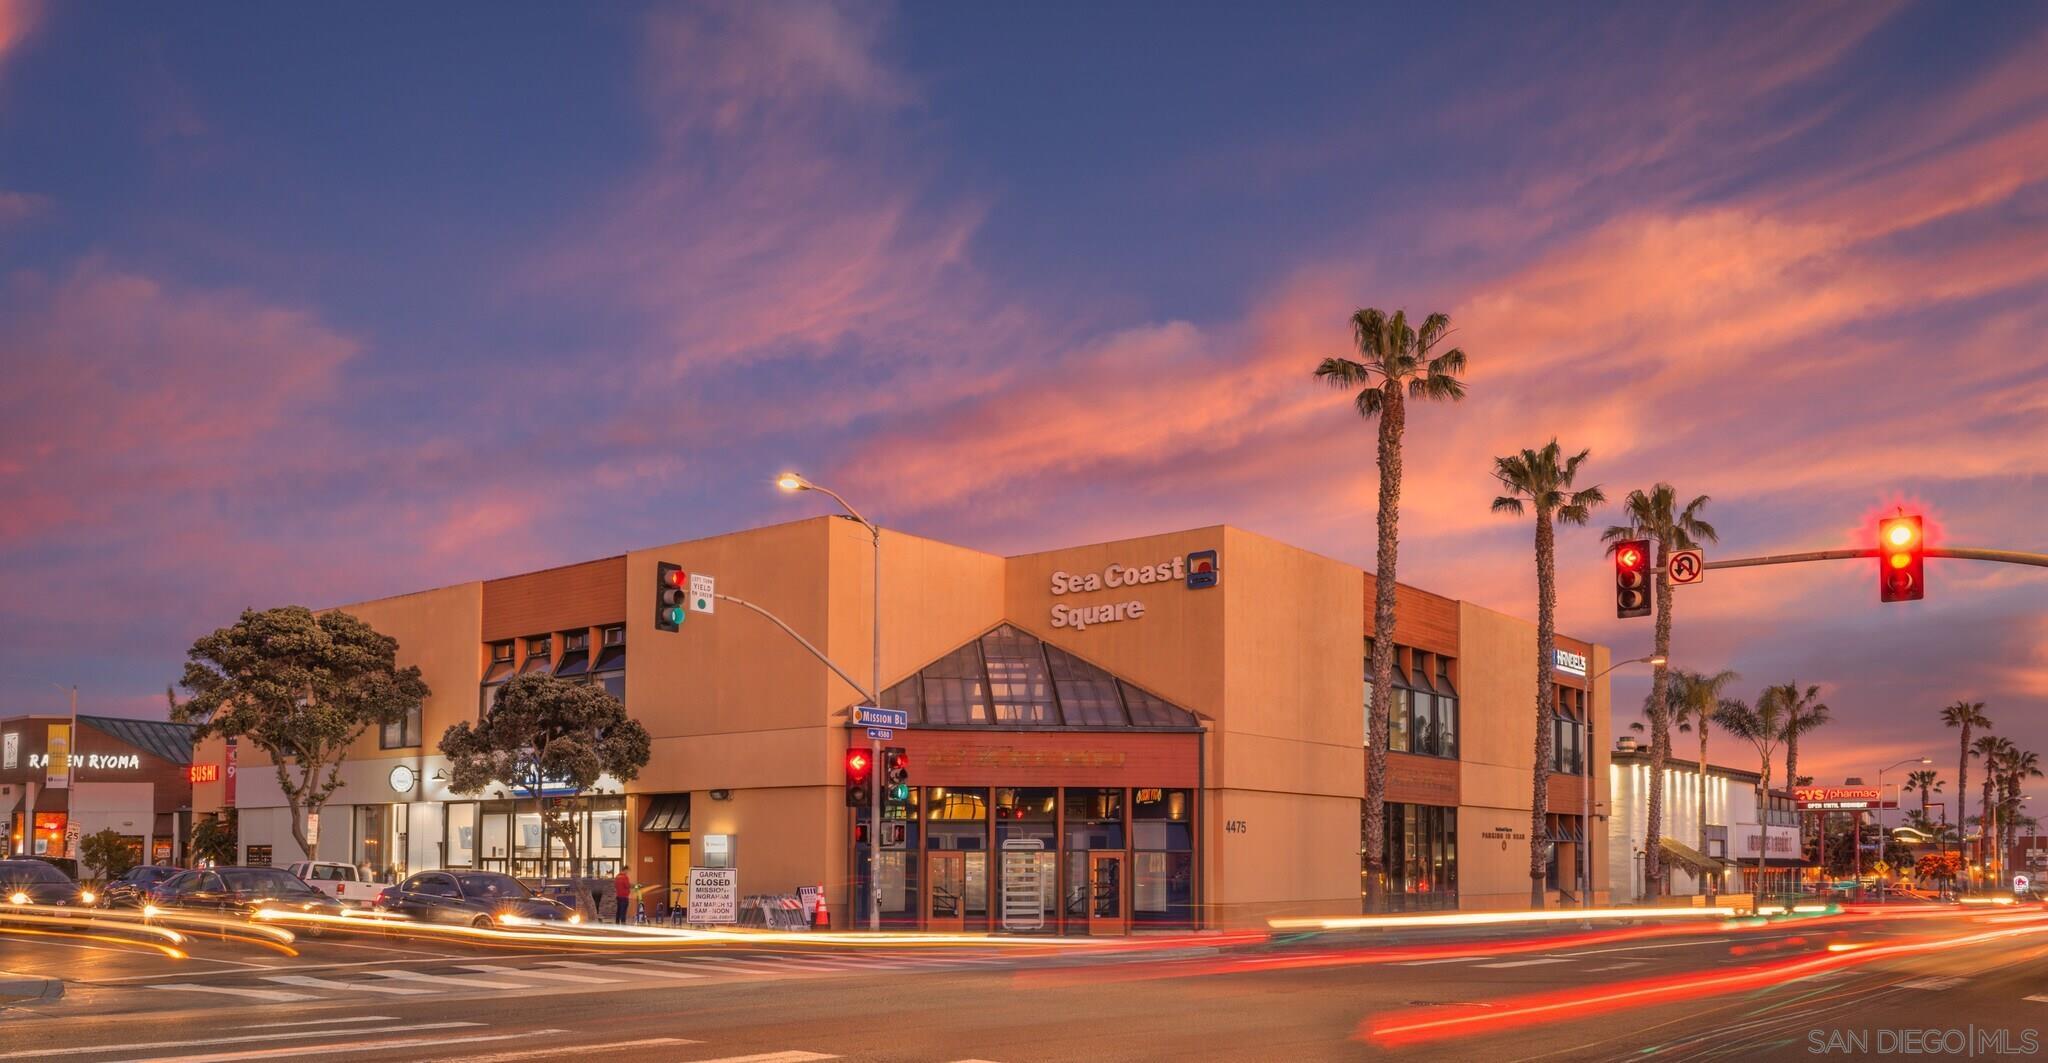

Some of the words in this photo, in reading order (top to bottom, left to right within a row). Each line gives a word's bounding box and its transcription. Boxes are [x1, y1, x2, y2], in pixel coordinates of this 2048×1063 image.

[1051, 571, 1101, 595] Sea
[1104, 556, 1185, 588] Coast
[693, 583, 712, 592] YIELD
[1051, 600, 1145, 631] Square
[863, 710, 892, 724] MISSION
[29, 754, 84, 769] RAEN
[88, 754, 140, 770] RYOMA
[191, 765, 217, 781] SUSHI
[1225, 820, 1247, 834] 4475
[66, 831, 79, 840] 25
